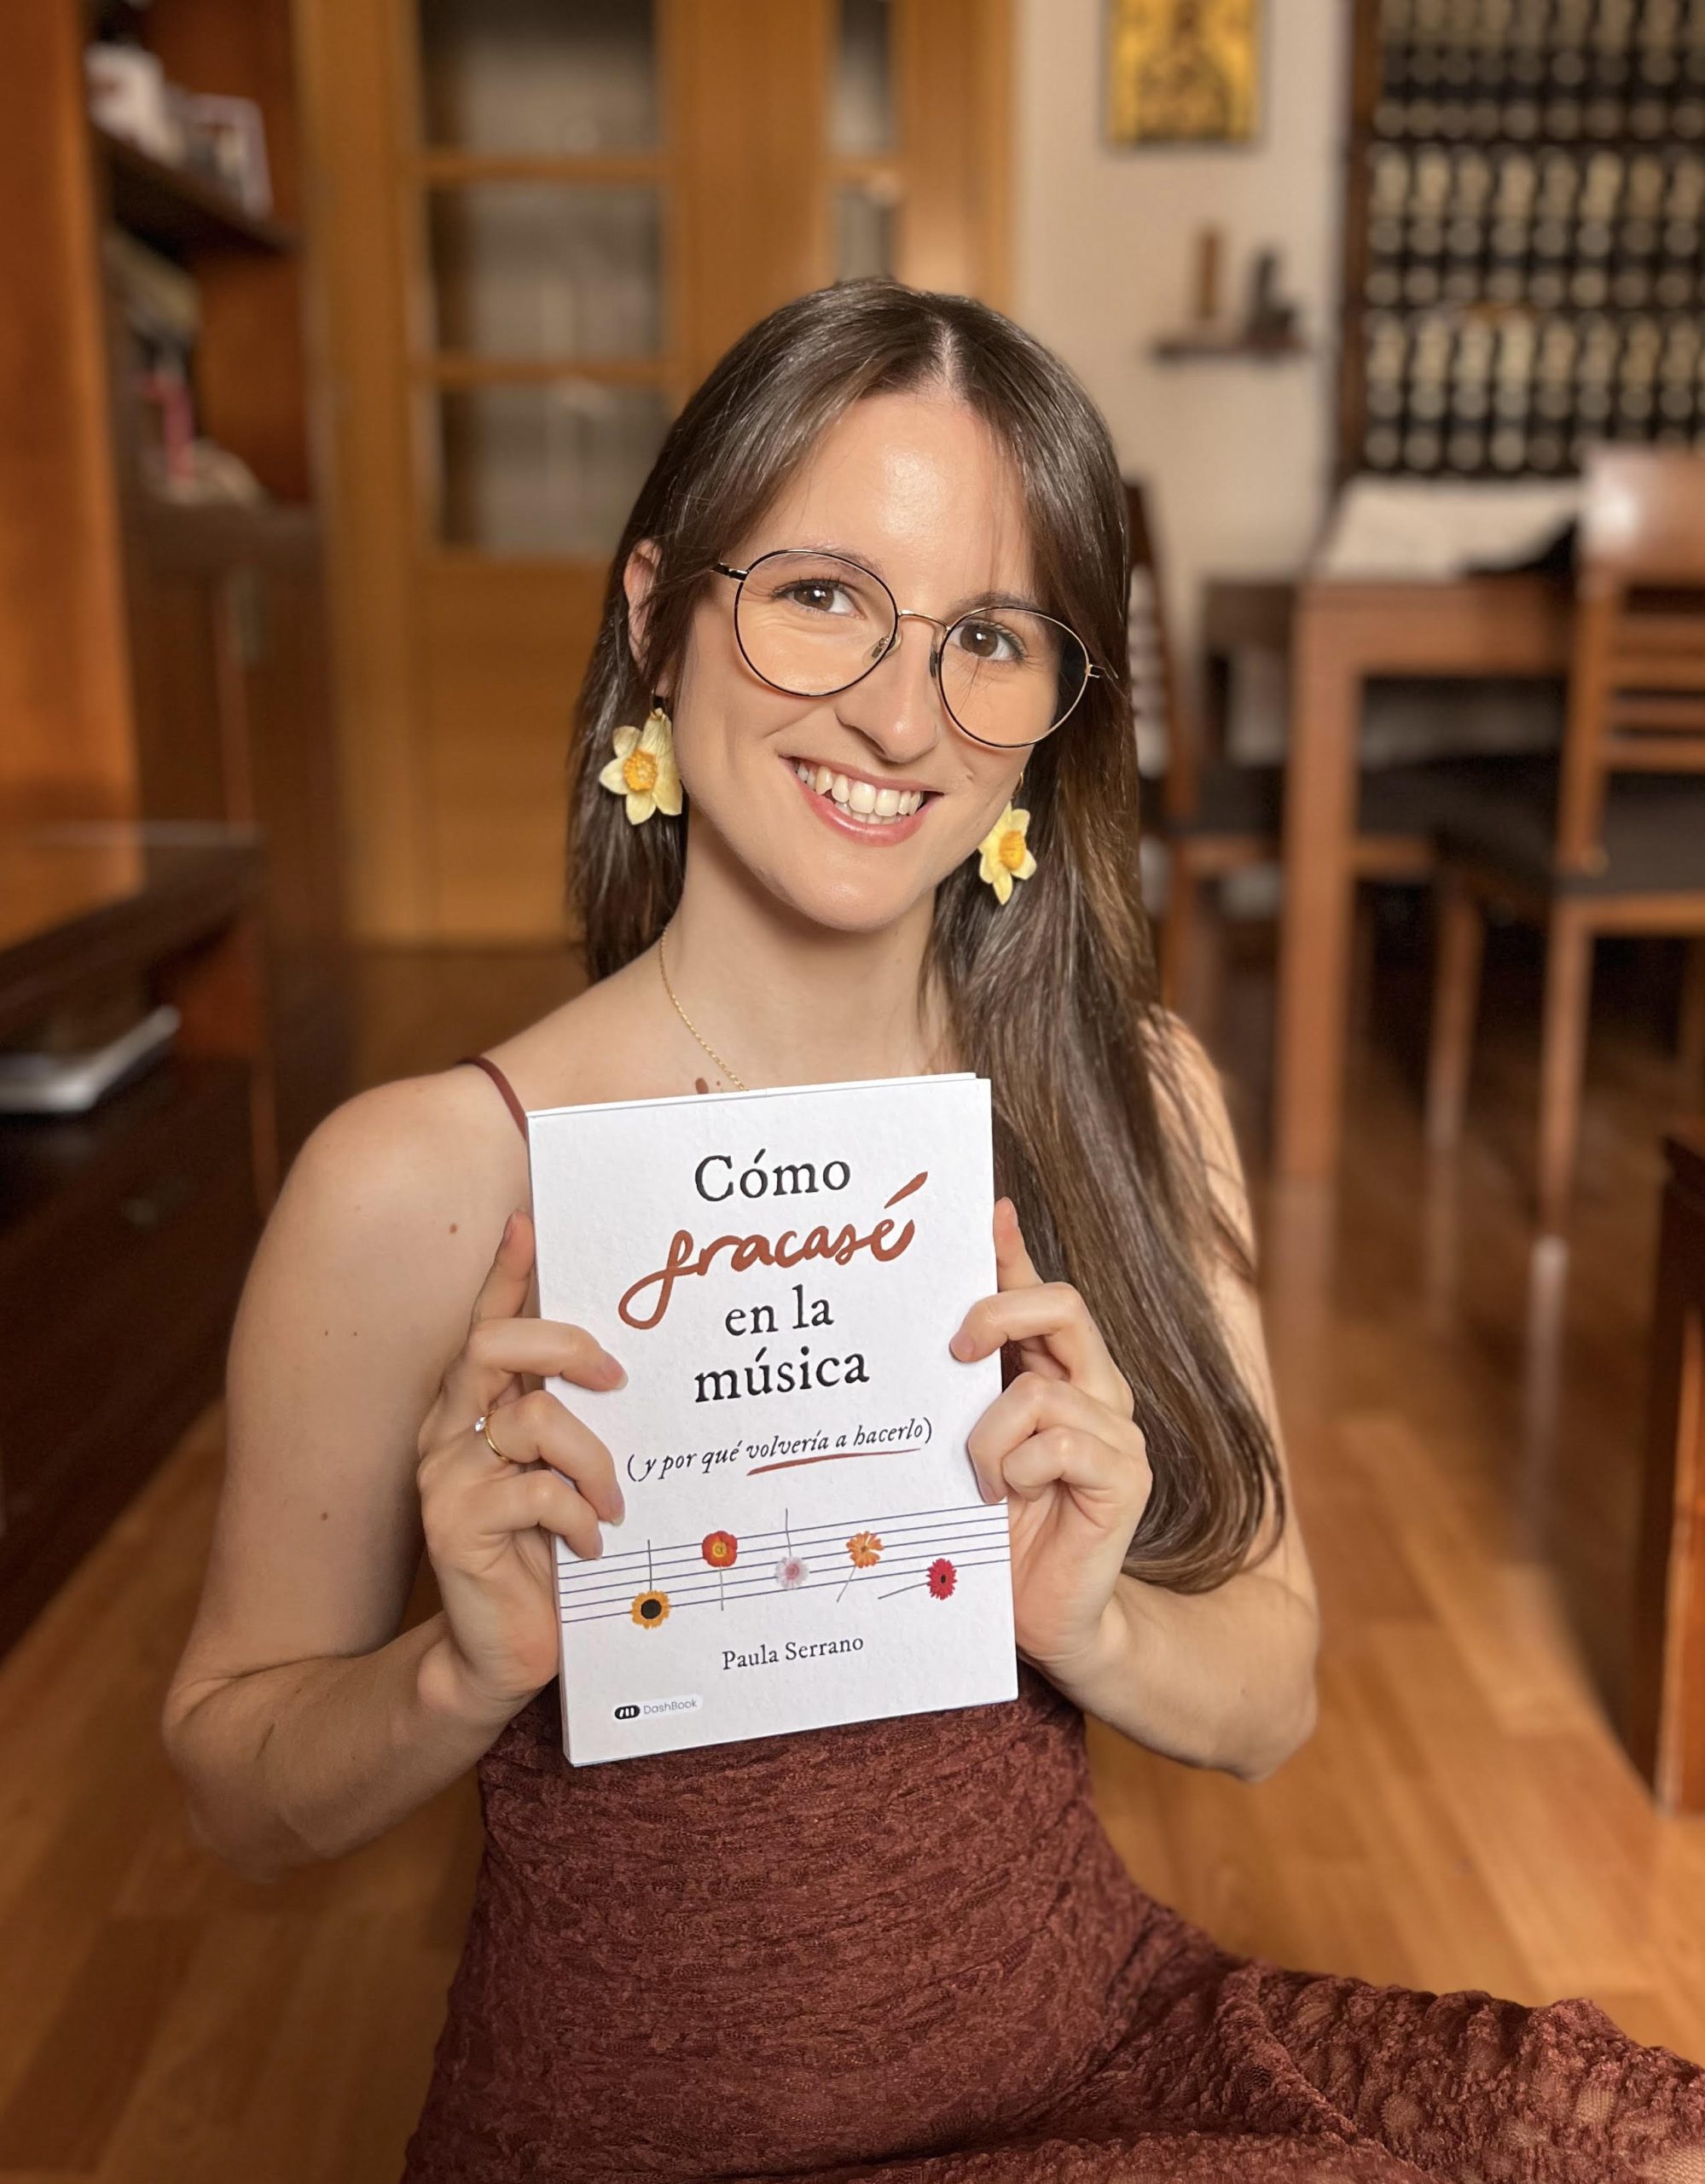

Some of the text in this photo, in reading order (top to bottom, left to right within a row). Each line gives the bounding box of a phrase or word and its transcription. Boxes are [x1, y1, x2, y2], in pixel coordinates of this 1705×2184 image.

[695, 1148, 850, 1202] Cómo
[618, 1170, 928, 1330] fracasé
[725, 1284, 835, 1336] en la
[694, 1345, 871, 1404] música
[658, 1453, 698, 1480] por
[702, 1439, 744, 1474] qué
[746, 1429, 830, 1460] volvería
[835, 1435, 847, 1449] a
[853, 1416, 934, 1448] hacerlo)
[722, 1637, 865, 1671] Paula Serrano
[643, 1699, 698, 1715] DashBook
